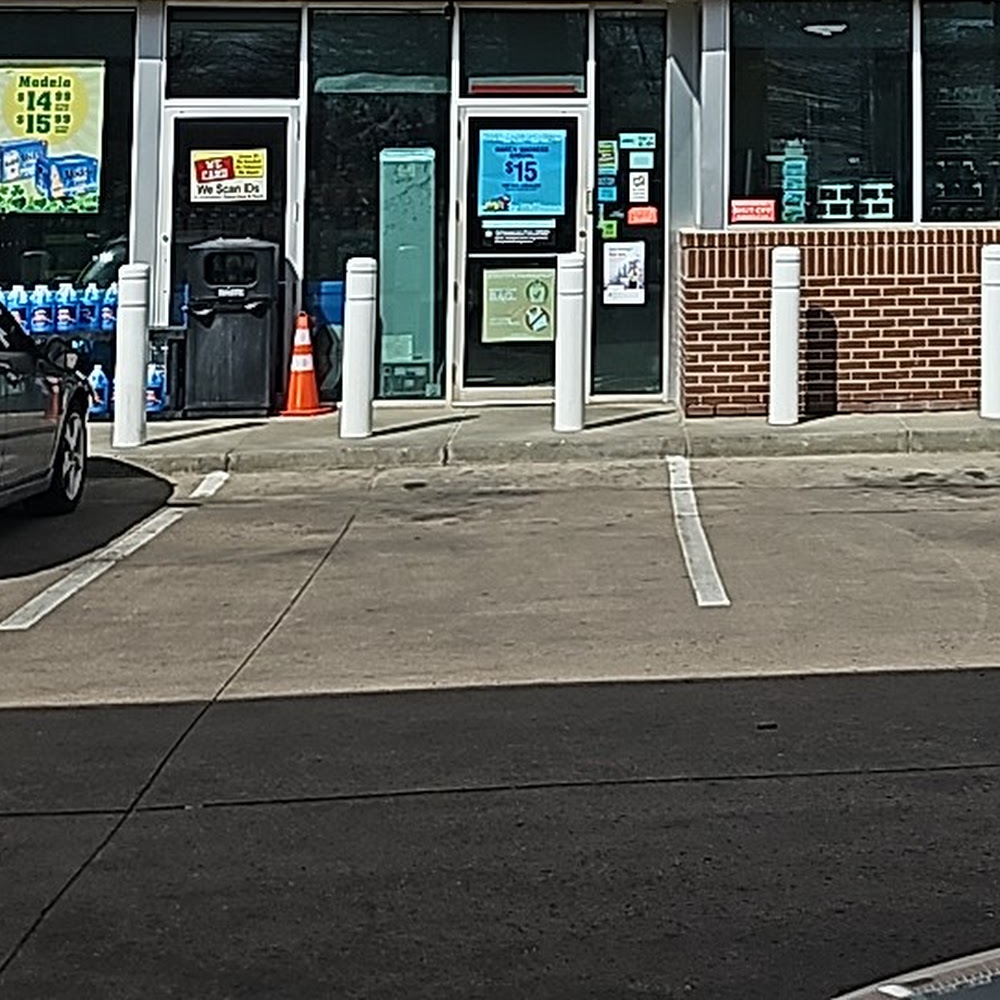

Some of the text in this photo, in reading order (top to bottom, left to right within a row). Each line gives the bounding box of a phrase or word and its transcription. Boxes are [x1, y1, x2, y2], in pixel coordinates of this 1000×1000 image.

[505, 161, 538, 182] $15
[197, 183, 260, 195] We Scan IDs
